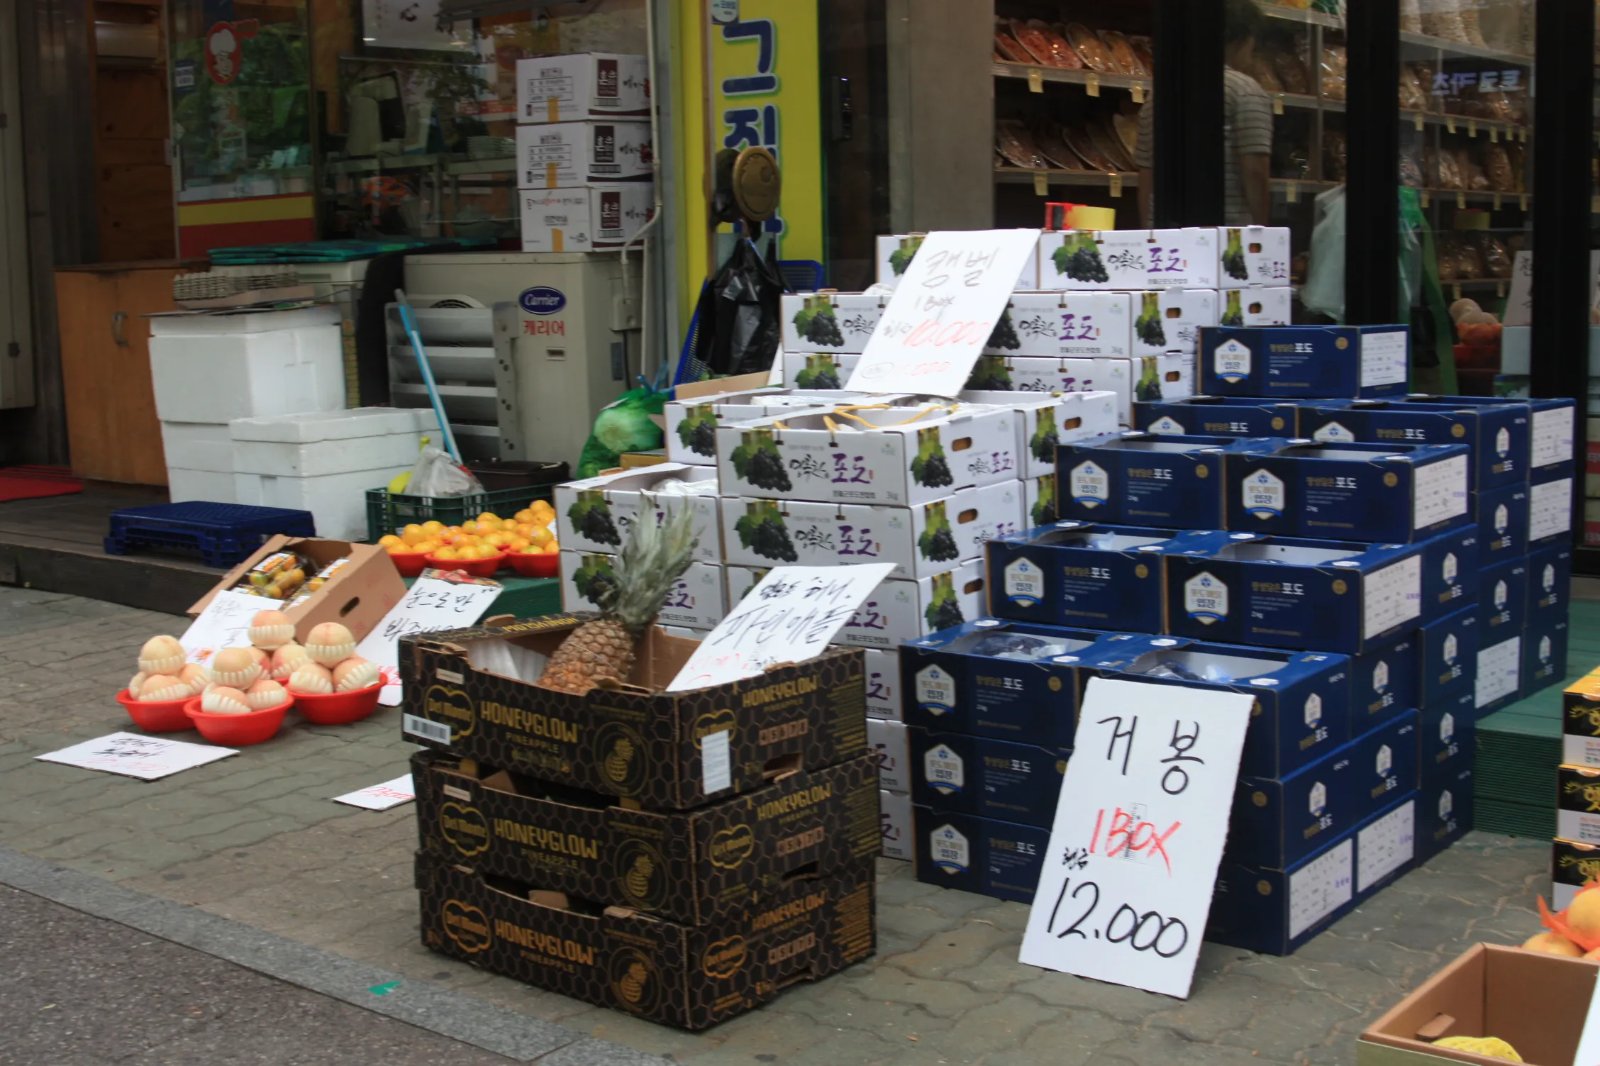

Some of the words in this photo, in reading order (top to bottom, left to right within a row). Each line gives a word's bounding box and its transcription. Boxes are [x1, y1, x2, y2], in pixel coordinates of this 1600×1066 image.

[1147, 247, 1184, 273] 포도
[524, 293, 560, 306] Carrier
[1059, 313, 1097, 341] 포도
[831, 453, 871, 484] 포도
[838, 525, 877, 557] 포도
[712, 603, 857, 650] 파인애플
[742, 675, 818, 708] HONEYGLOW
[480, 700, 579, 744] HONEYGLOW
[505, 732, 560, 754] PINEAPPLE
[1096, 715, 1205, 795] 거봉
[757, 782, 832, 821] HONEYGLOW
[494, 818, 598, 861] HONEYGLOW
[1047, 877, 1188, 958] 12.000
[494, 918, 594, 966] HONEYGLOW
